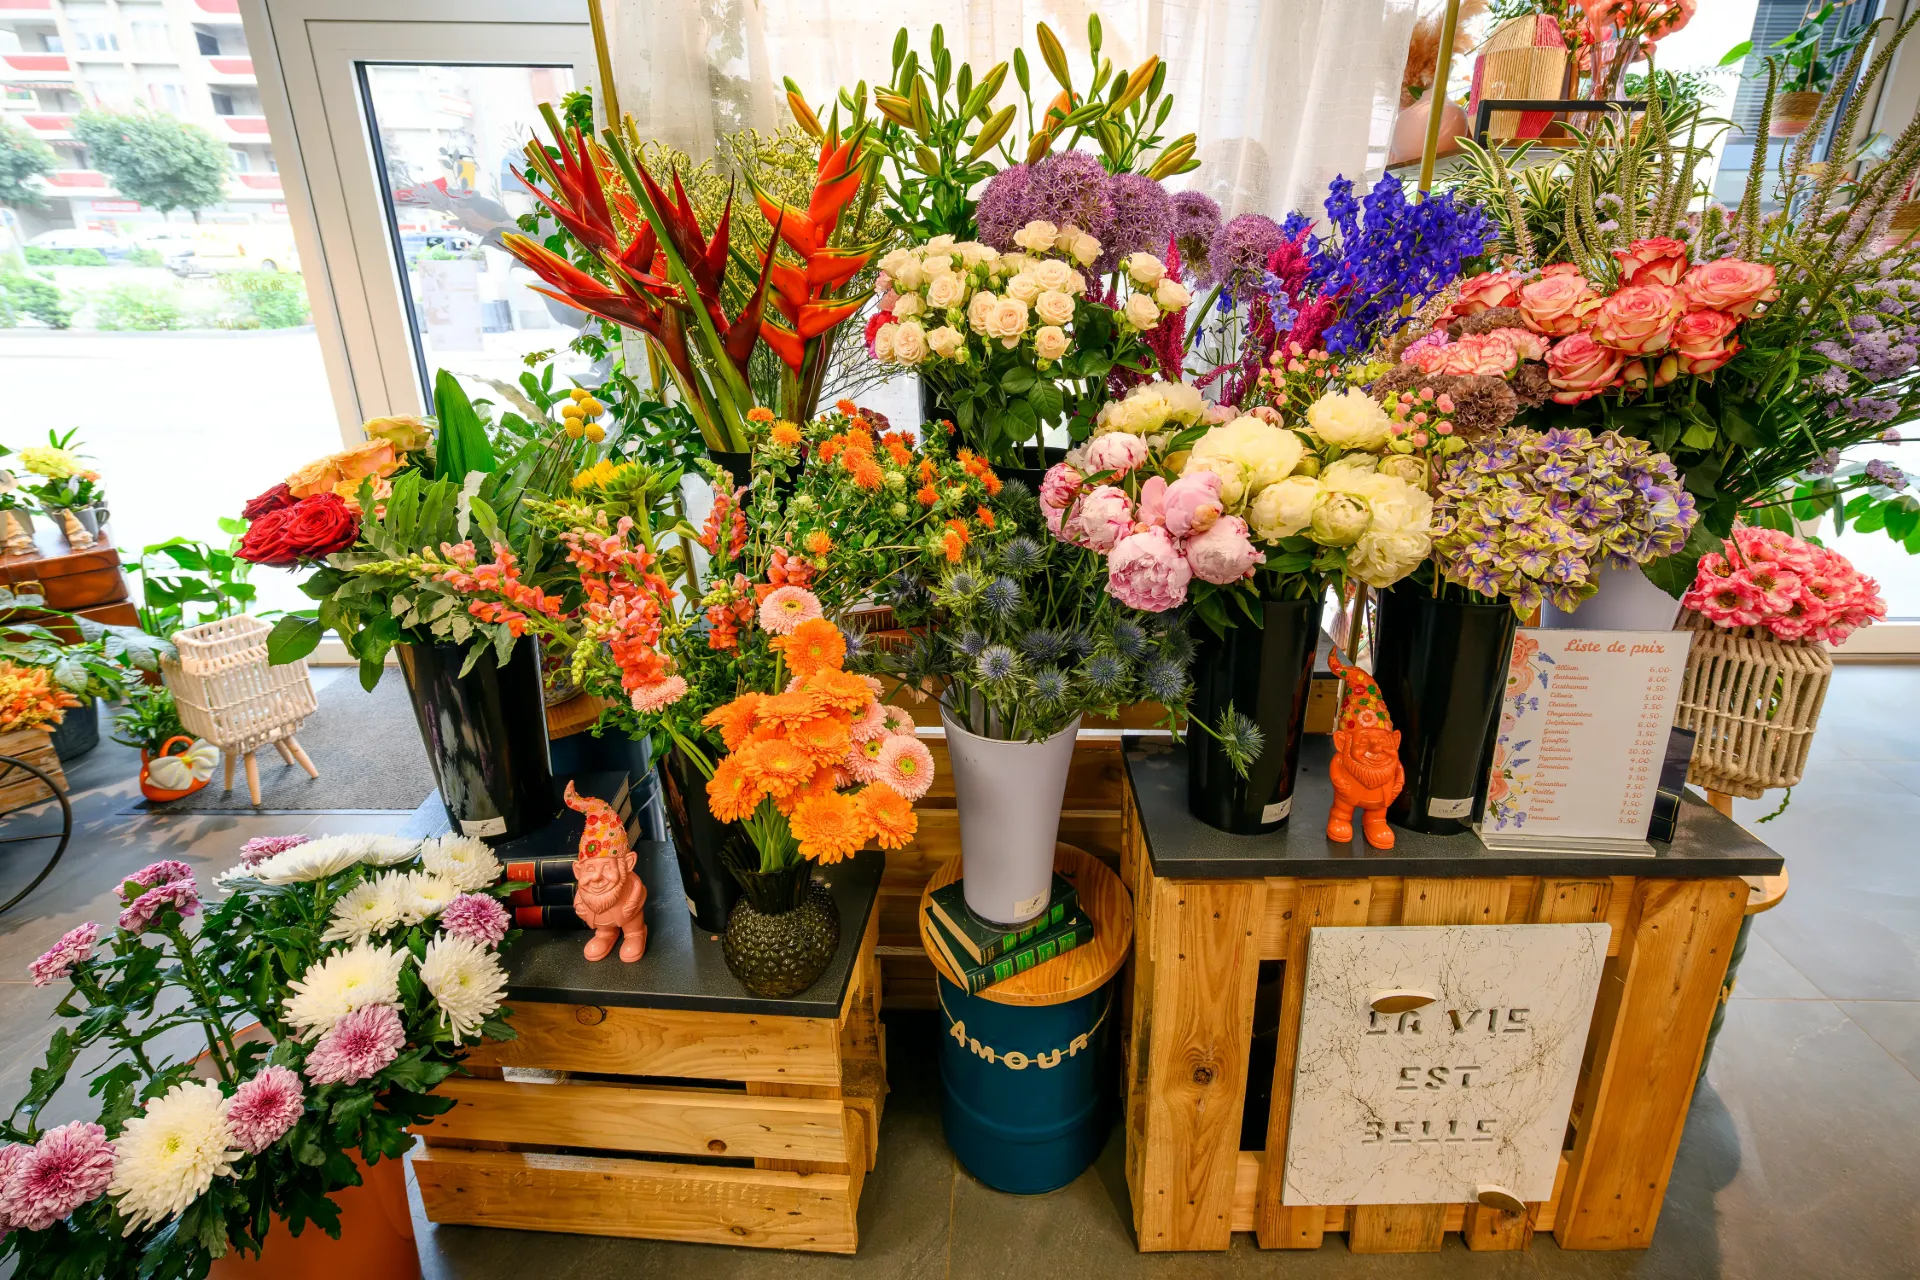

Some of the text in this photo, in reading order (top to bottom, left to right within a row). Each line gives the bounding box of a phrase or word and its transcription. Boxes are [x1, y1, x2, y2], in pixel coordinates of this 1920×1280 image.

[1564, 639, 1665, 656] Liste de prix
[1366, 1008, 1530, 1035] LA VIE
[950, 1020, 1088, 1070] AMOUR
[1396, 1066, 1481, 1091] EST
